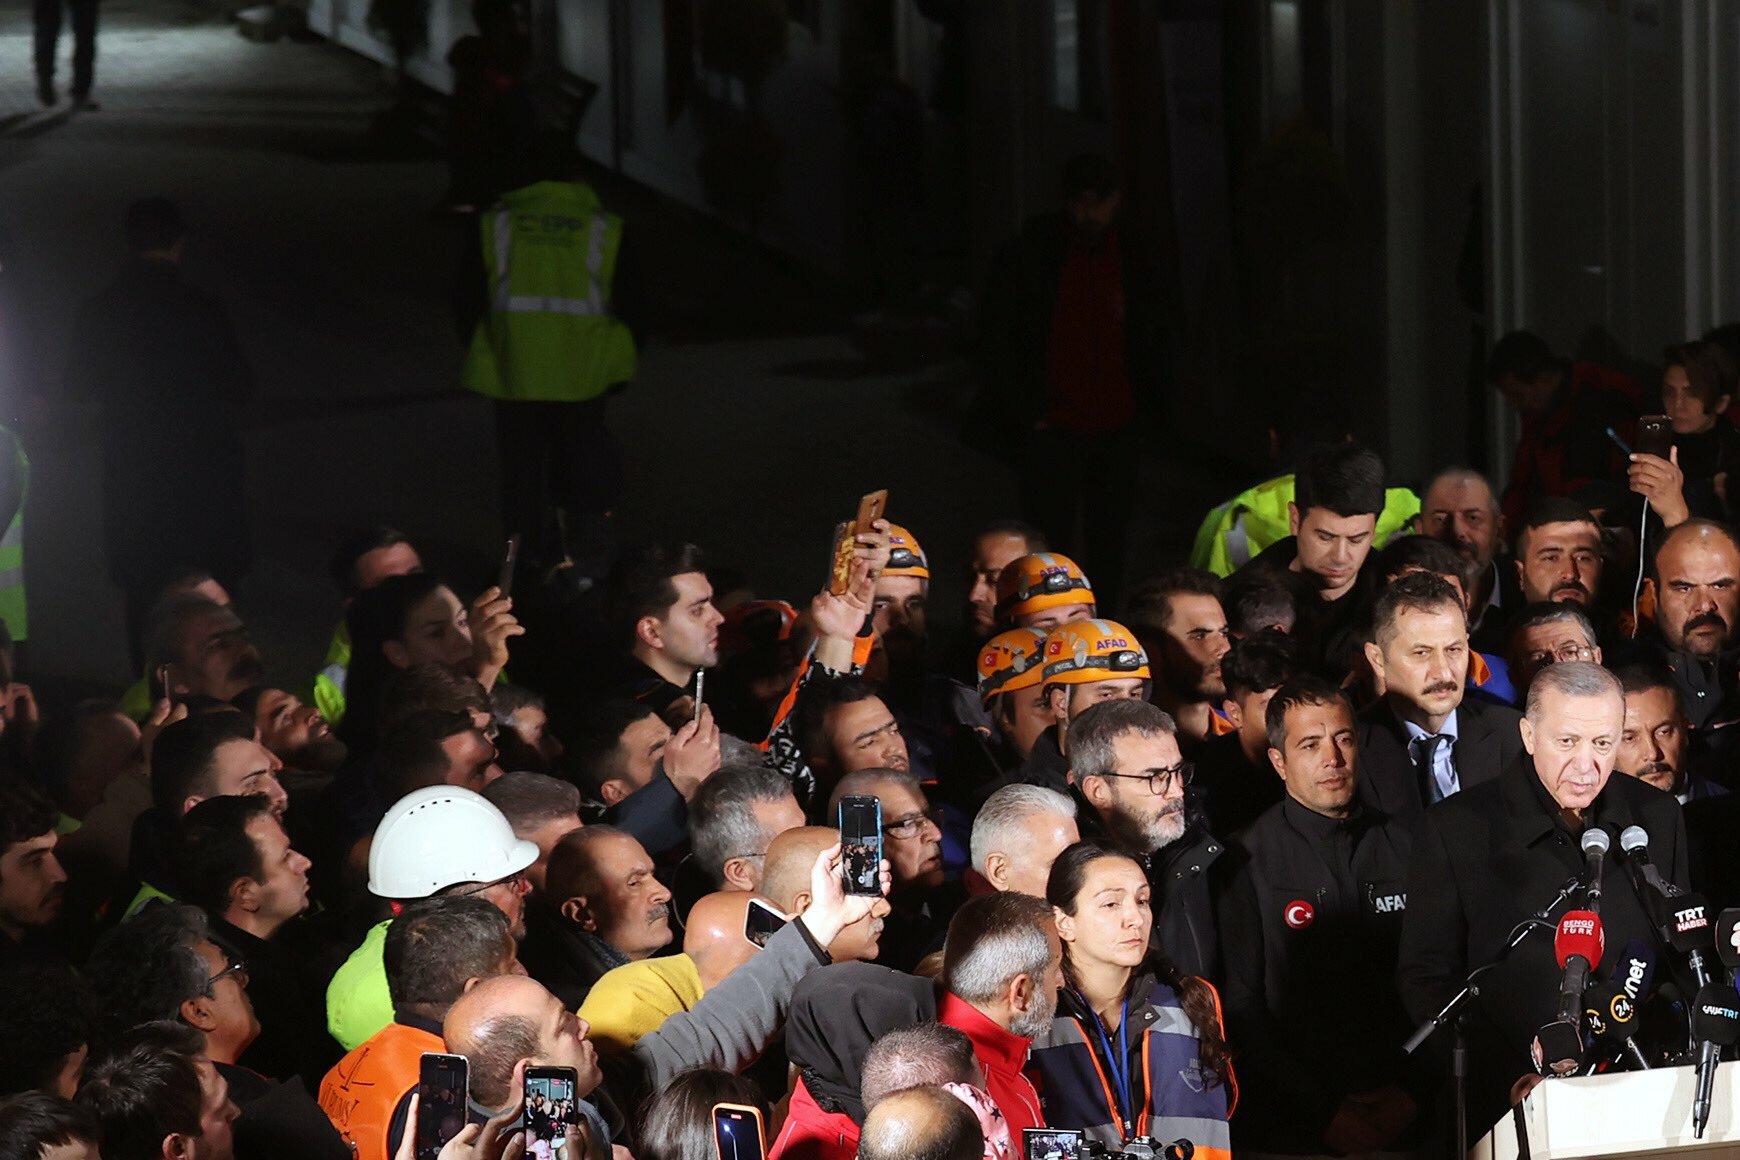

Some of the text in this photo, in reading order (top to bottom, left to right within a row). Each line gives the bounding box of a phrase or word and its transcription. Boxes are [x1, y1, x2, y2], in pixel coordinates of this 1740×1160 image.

[1096, 638, 1128, 650] AFAD
[1375, 893, 1407, 914] AFA
[1674, 906, 1705, 923] TRT
[1676, 918, 1708, 932] HABER
